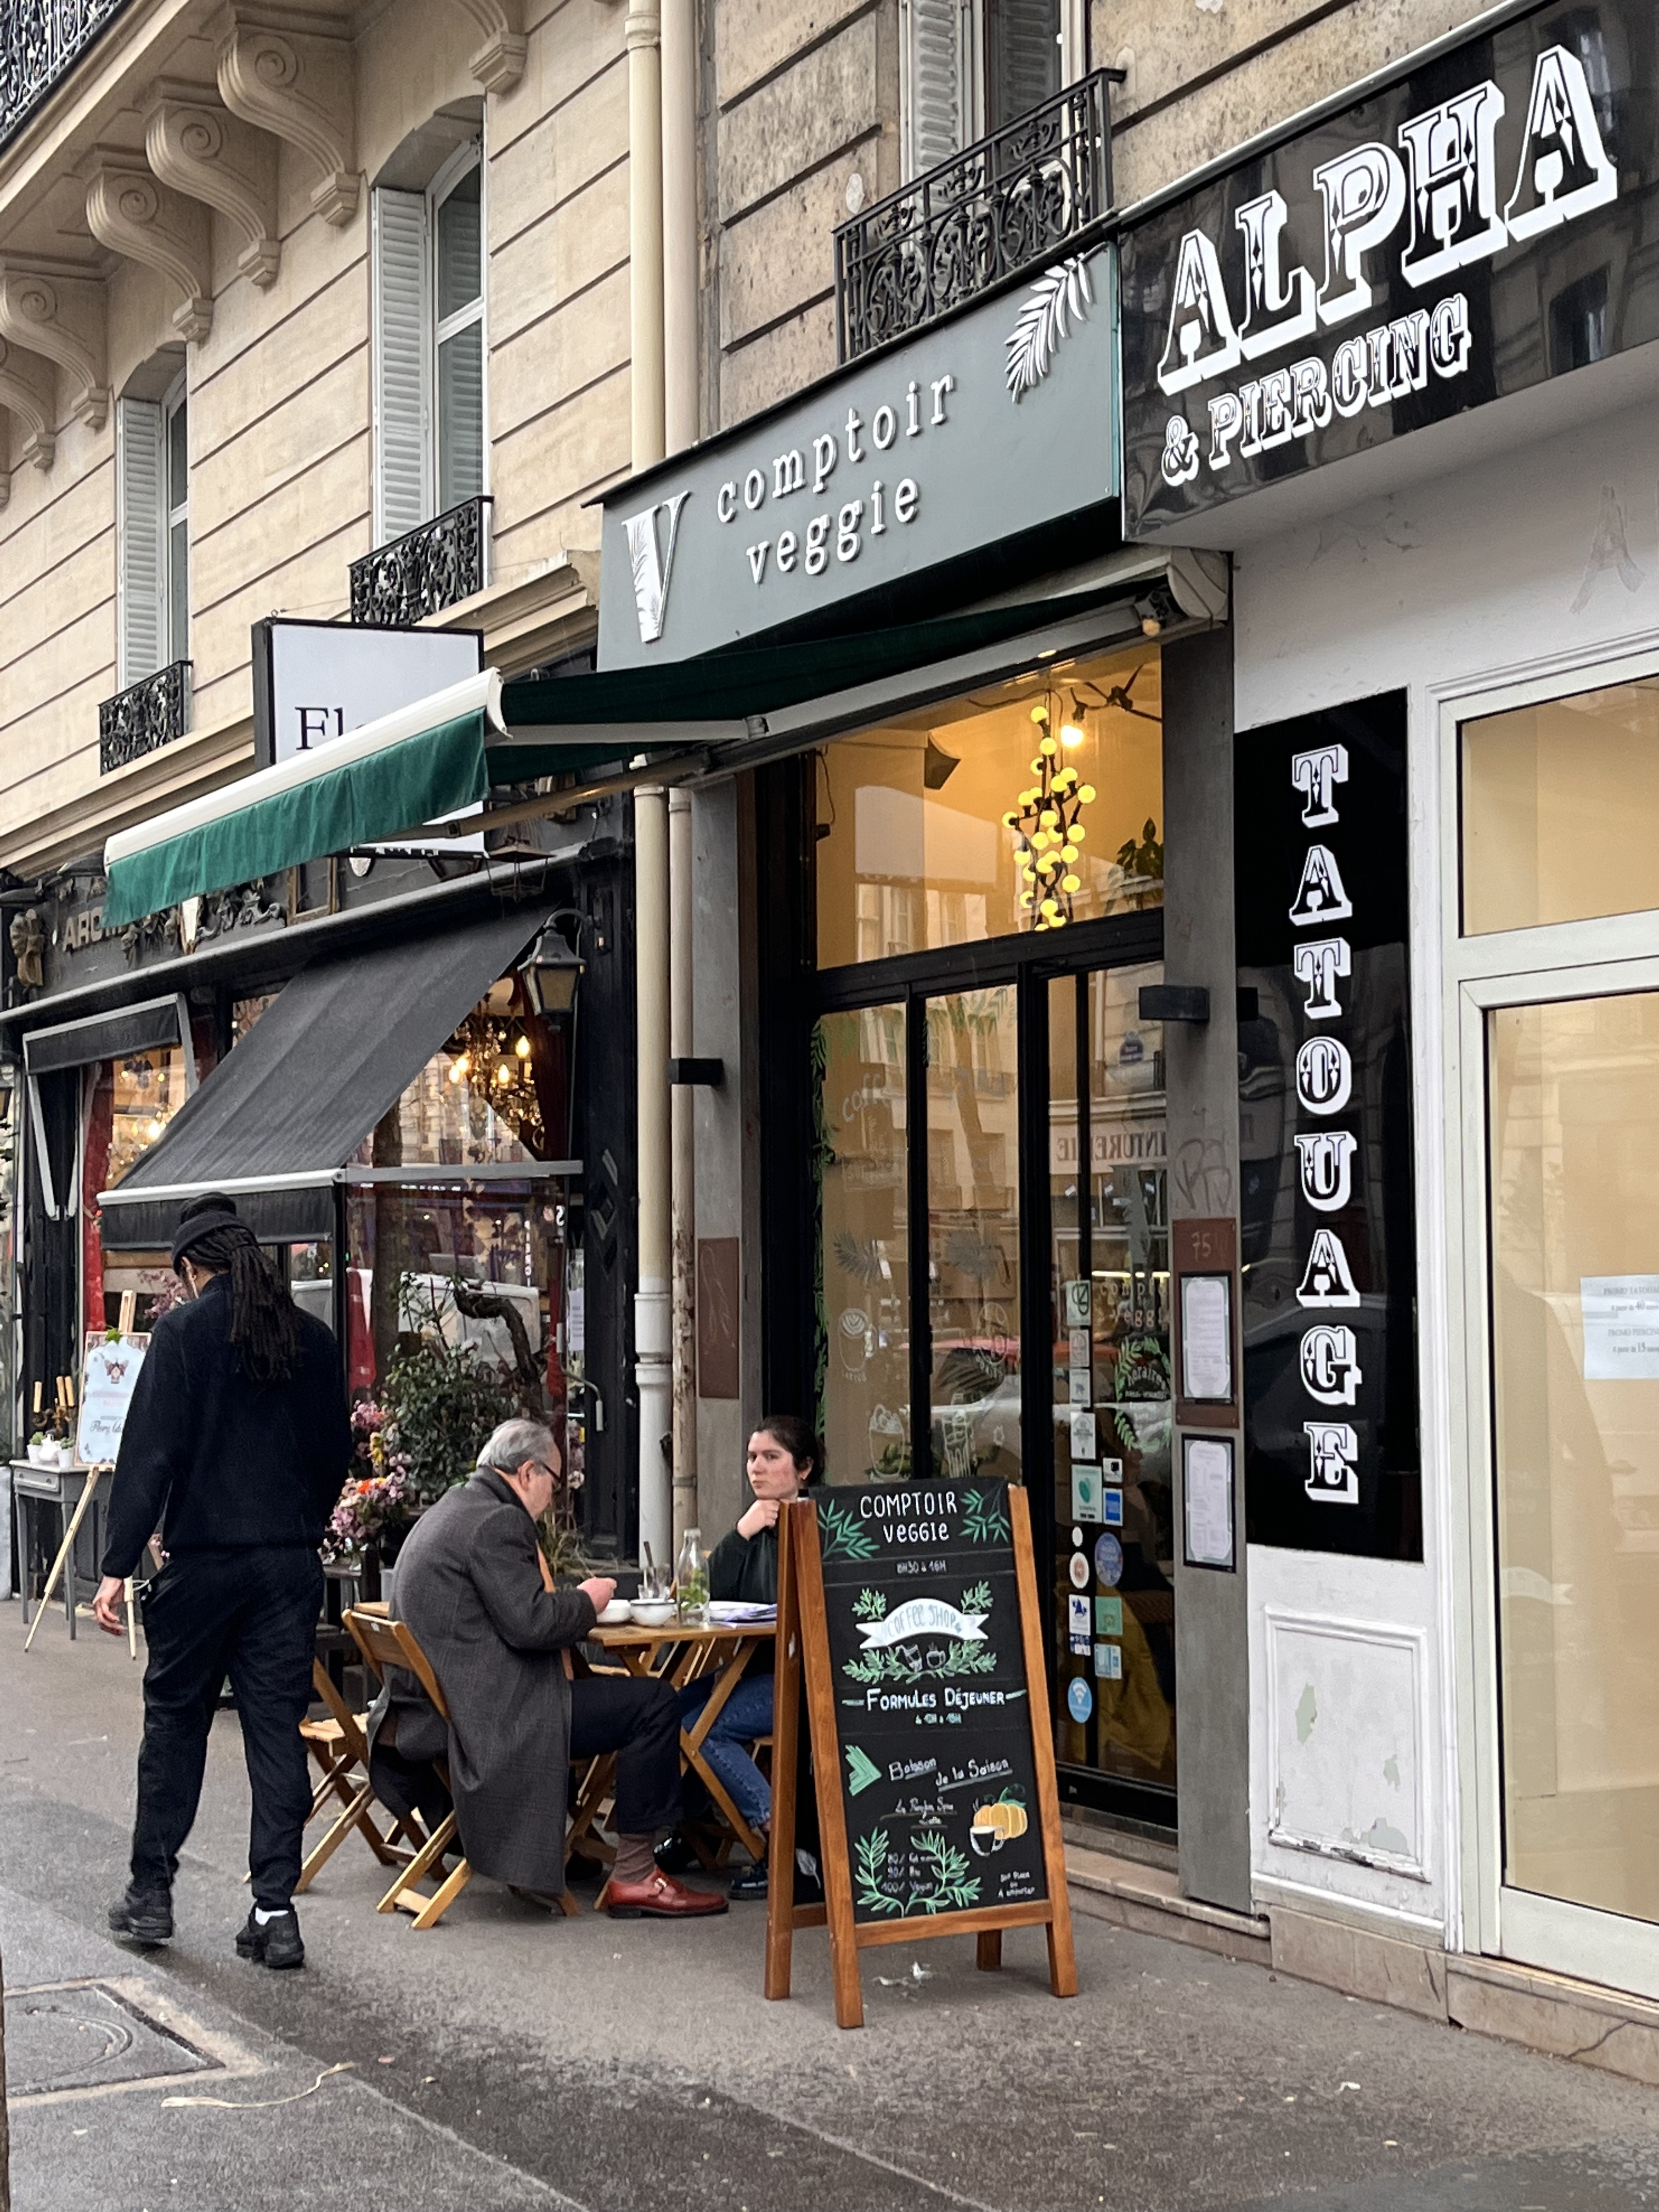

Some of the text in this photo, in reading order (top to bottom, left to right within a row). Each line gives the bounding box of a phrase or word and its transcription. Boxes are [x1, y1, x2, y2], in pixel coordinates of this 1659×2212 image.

[1158, 44, 1618, 396] ALPHA
[718, 373, 956, 523] comptoir
[1161, 293, 1471, 486] & PIERCING
[746, 478, 921, 585] veggie
[295, 707, 366, 750] Fl
[63, 906, 122, 952] ARC
[1289, 743, 1362, 1504] TATOUAGE
[860, 1491, 958, 1519] COMPTOIR
